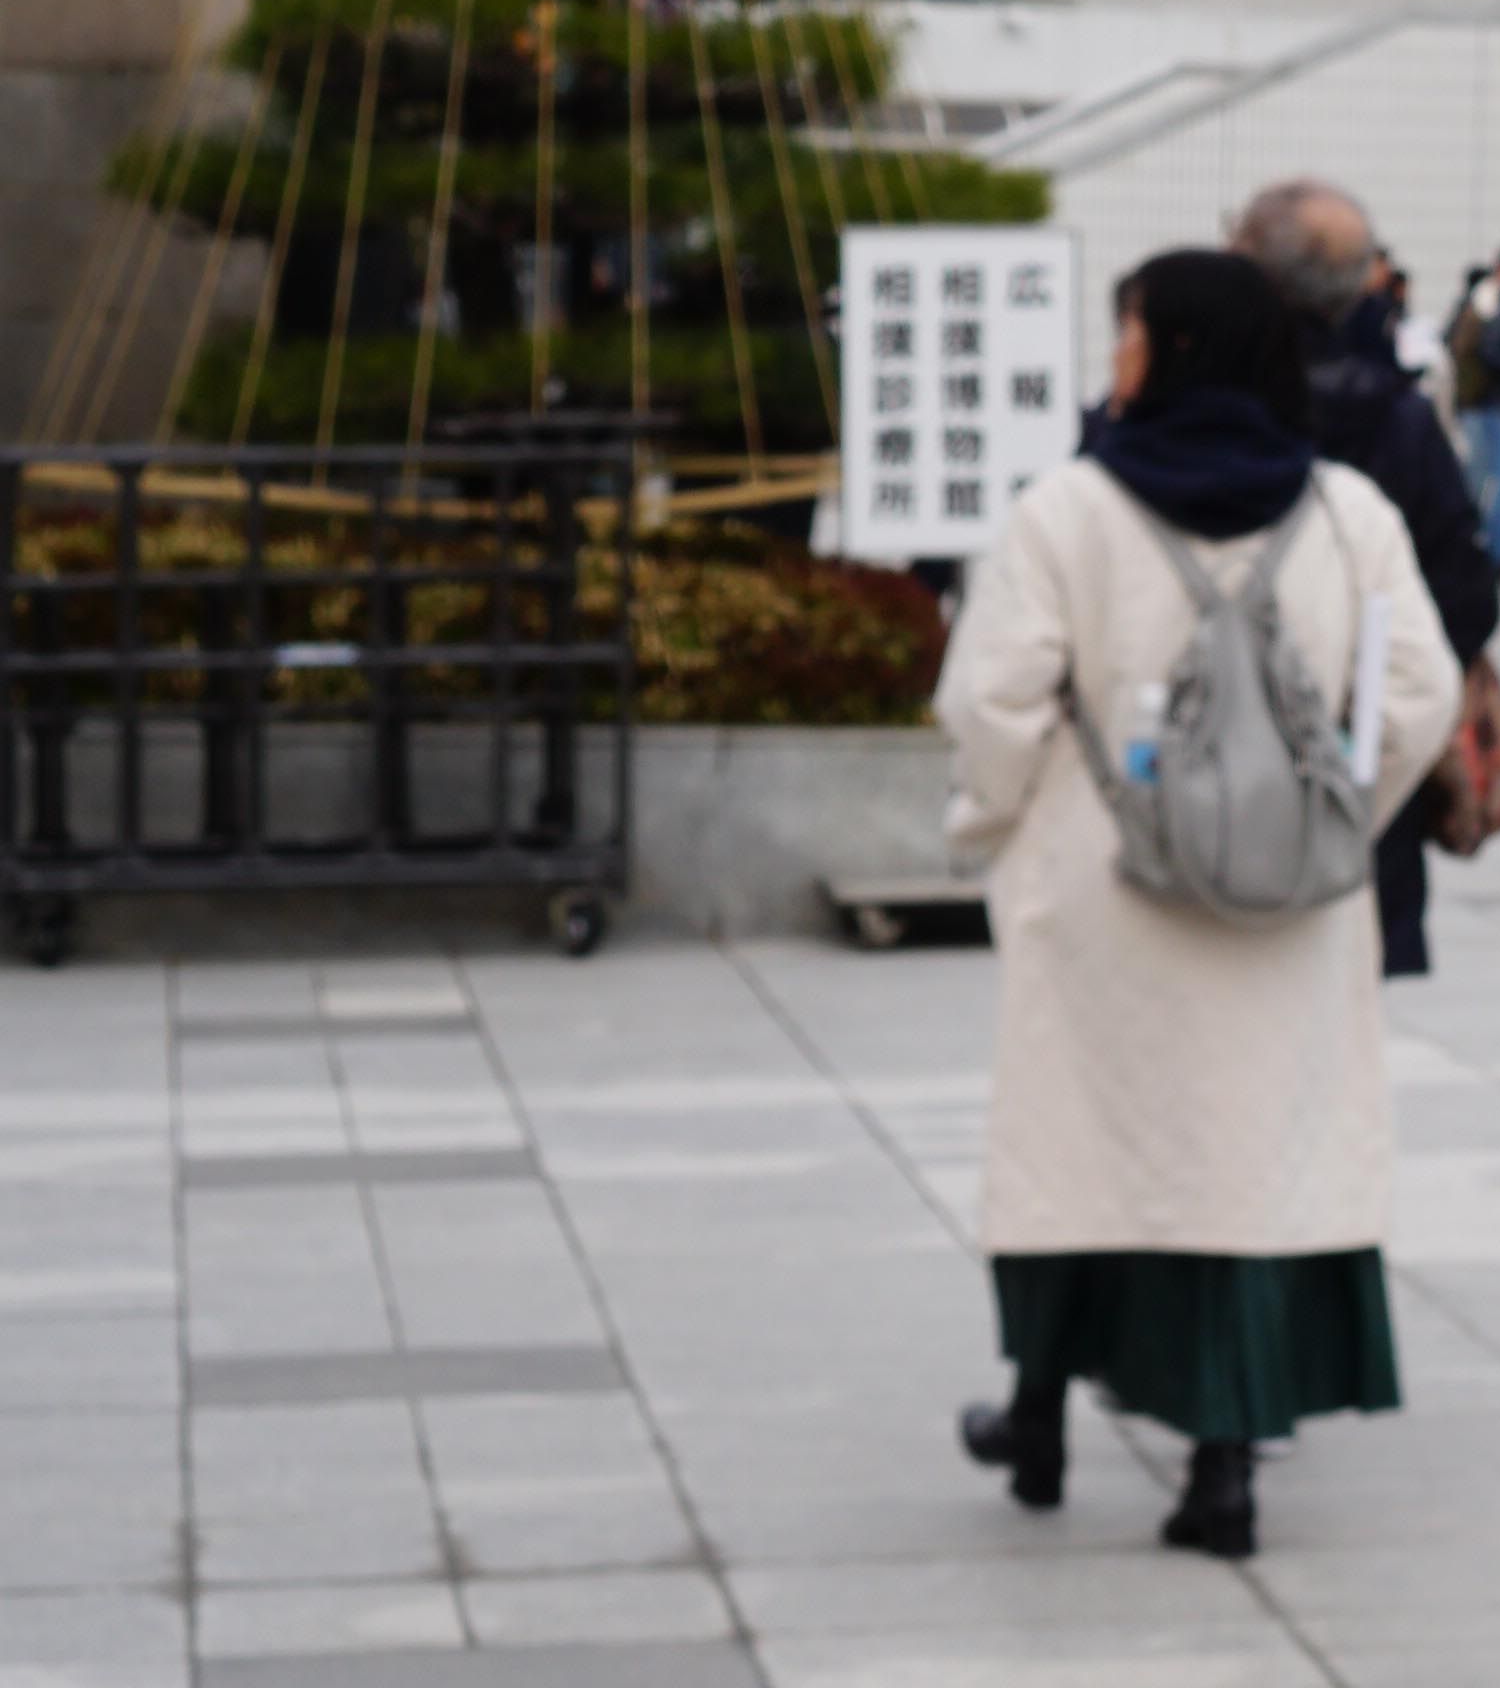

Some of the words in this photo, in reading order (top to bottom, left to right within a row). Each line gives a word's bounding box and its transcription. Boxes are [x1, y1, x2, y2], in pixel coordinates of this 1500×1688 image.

[871, 266, 917, 516] 相撲診療所
[940, 266, 986, 520] 相撲博物館
[1008, 265, 1053, 496] 広報
